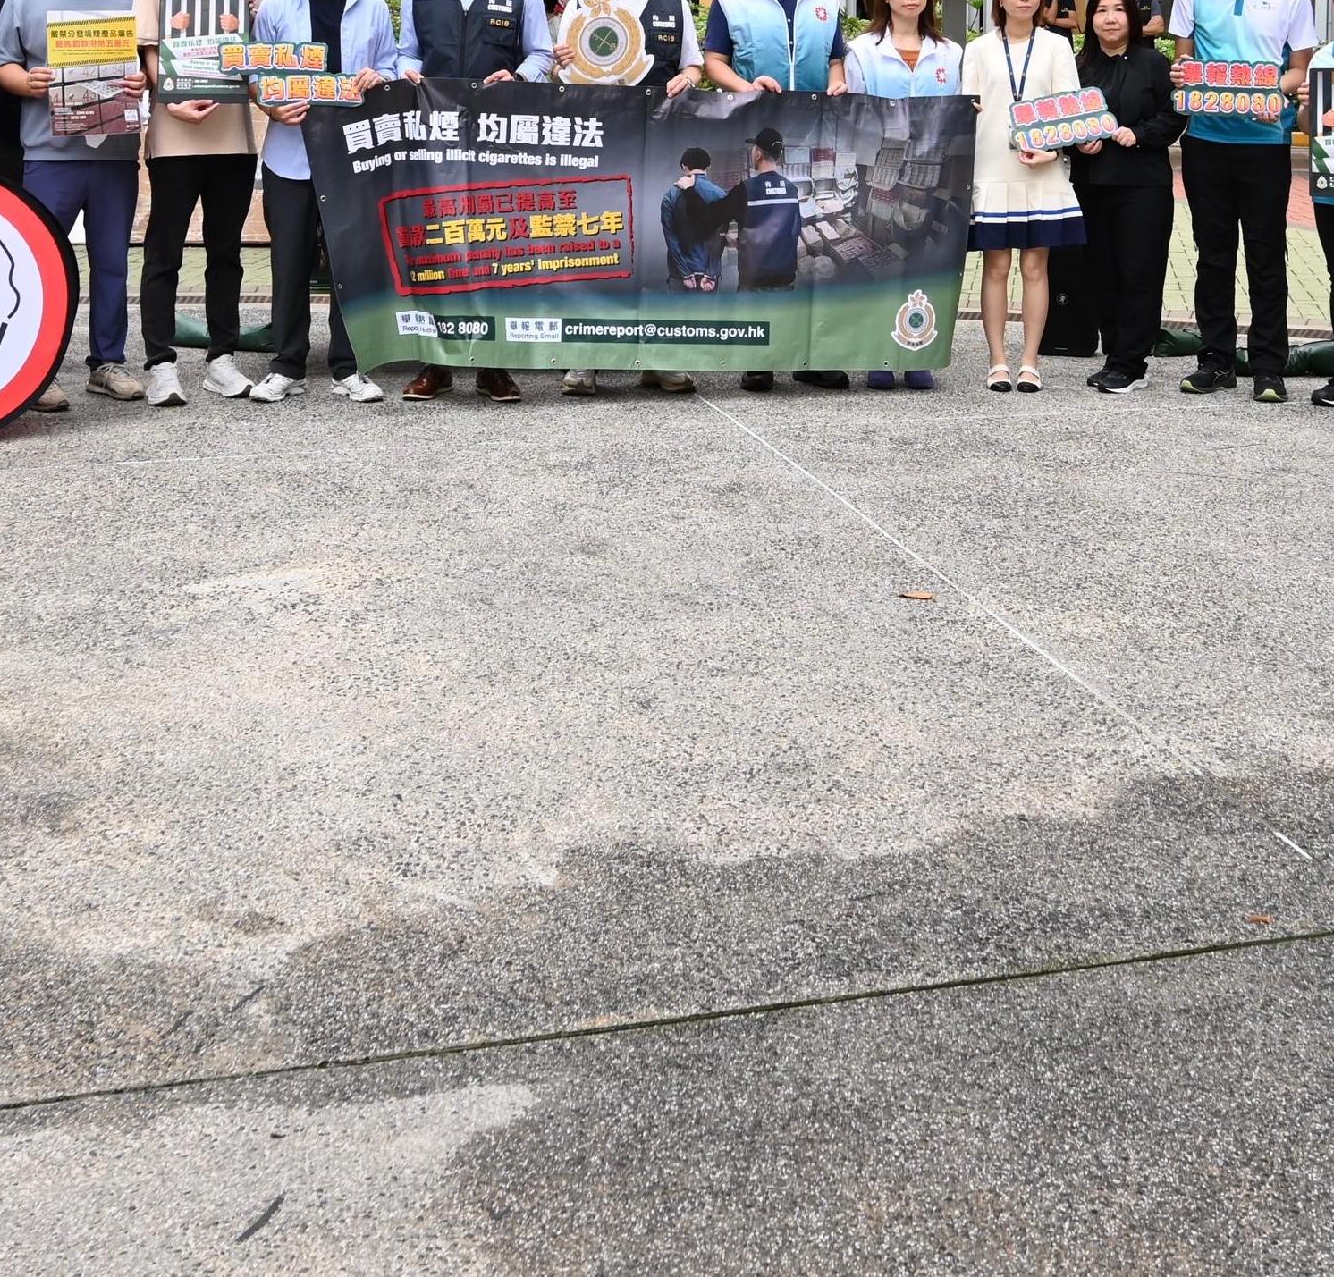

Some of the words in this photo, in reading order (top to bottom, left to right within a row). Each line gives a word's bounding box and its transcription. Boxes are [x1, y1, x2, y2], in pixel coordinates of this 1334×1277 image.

[222, 44, 326, 71] 買賣私煙
[1181, 60, 1280, 87] 舉報熱線
[261, 75, 362, 101] 均屬違法
[1013, 90, 1106, 126] 舉報熱線
[1173, 90, 1283, 114] 1828080
[342, 109, 460, 154] 買賣私煙
[477, 112, 605, 148] 均屬違法
[1016, 113, 1118, 151] 1828080
[352, 152, 391, 174] Buying
[394, 150, 407, 161] or
[409, 148, 443, 164] selling
[446, 148, 476, 162] illicit
[478, 151, 543, 167] cigarettes
[545, 153, 557, 166] is
[560, 153, 599, 169] illegal
[558, 240, 596, 254] raised
[599, 239, 611, 250] to
[417, 269, 445, 282] million
[492, 262, 498, 274] 7
[501, 259, 536, 275] years'
[537, 253, 621, 272] imprisonment
[458, 321, 489, 336] 8080
[564, 323, 766, 340] crimereport@customs.gov.hk
